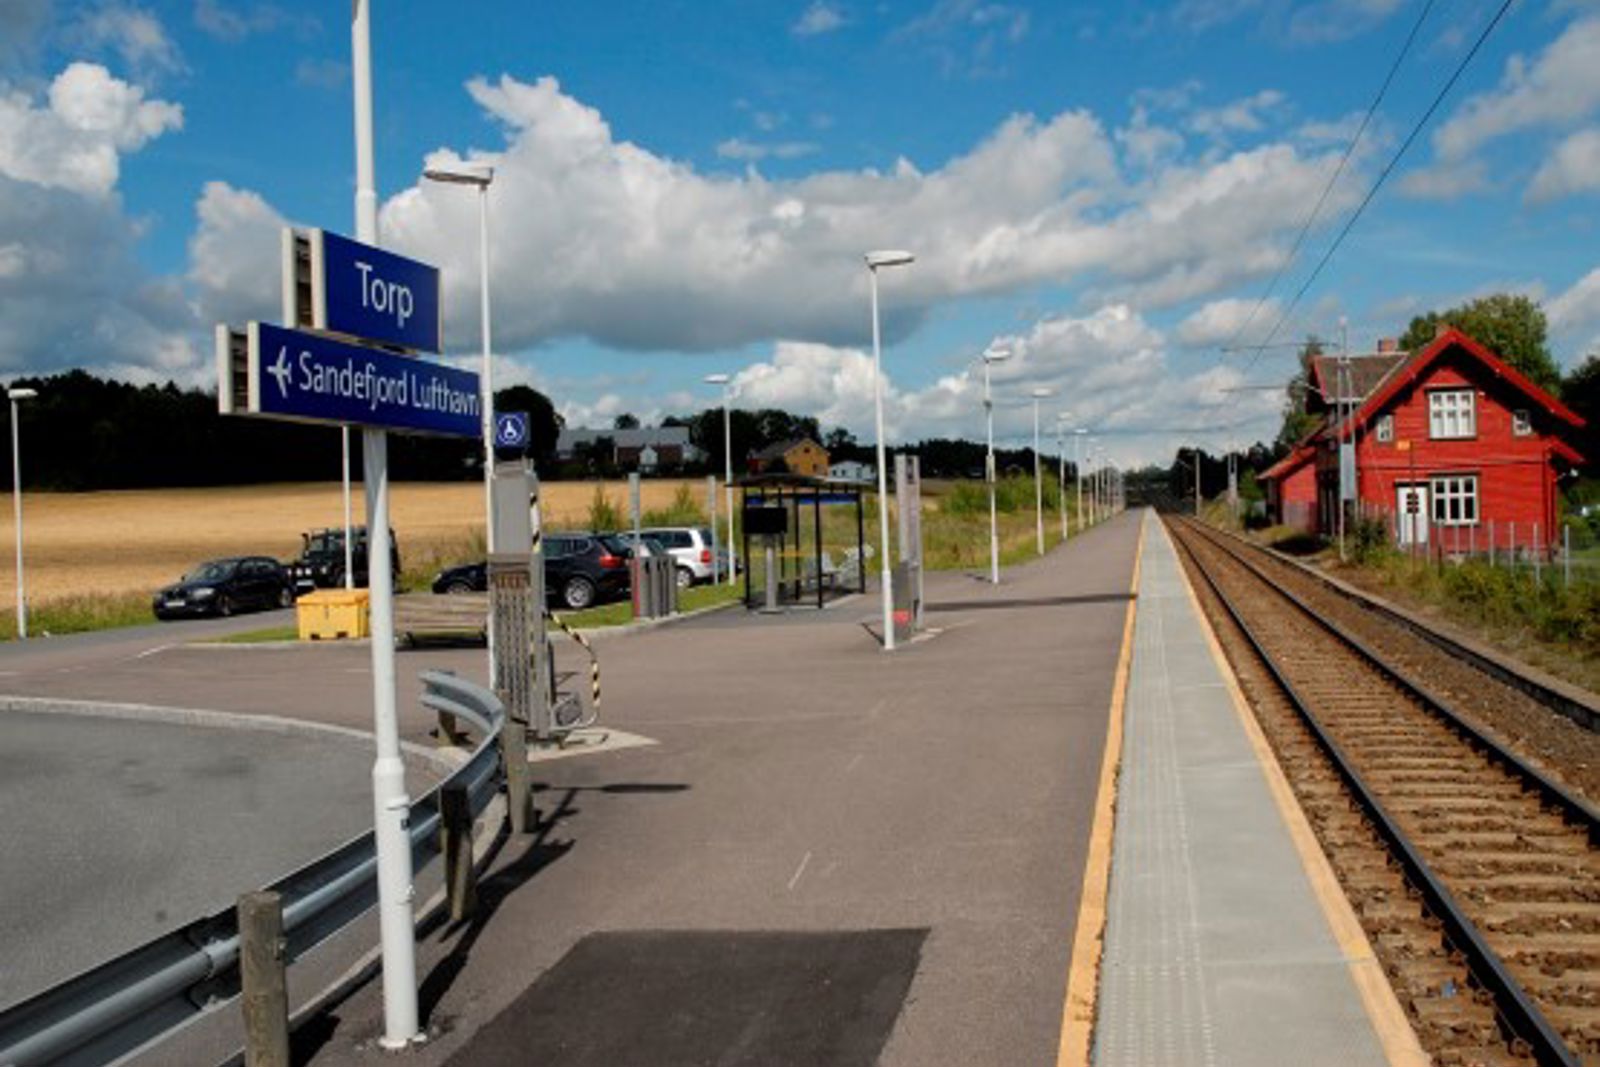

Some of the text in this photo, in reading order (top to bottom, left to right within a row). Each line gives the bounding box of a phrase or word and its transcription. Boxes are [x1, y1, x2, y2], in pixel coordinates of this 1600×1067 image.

[354, 261, 413, 328] Torp
[298, 351, 480, 417] Sandefjord Lufthavn
